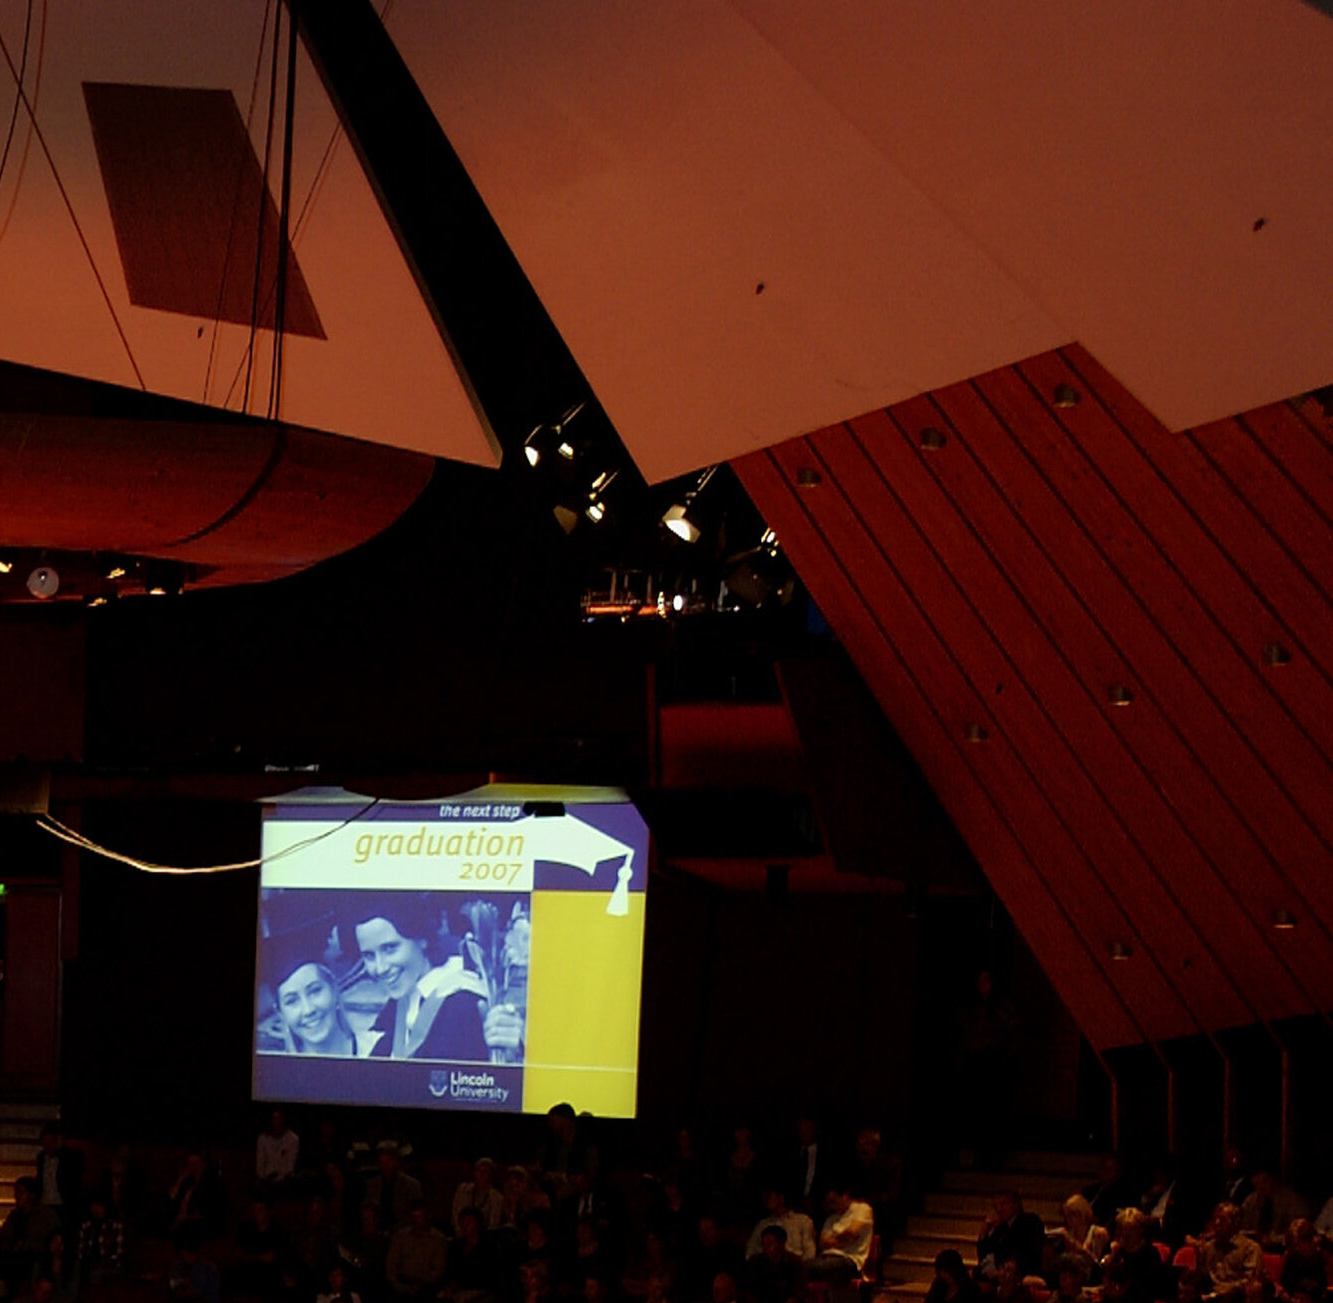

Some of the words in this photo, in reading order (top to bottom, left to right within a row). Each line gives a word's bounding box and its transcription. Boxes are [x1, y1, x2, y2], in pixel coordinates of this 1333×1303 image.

[439, 804, 459, 818] the
[463, 804, 489, 818] next
[494, 805, 520, 820] step
[354, 827, 524, 863] graduation
[458, 863, 522, 885] 2007
[450, 1071, 494, 1086] Lincoln
[450, 1084, 509, 1102] University
